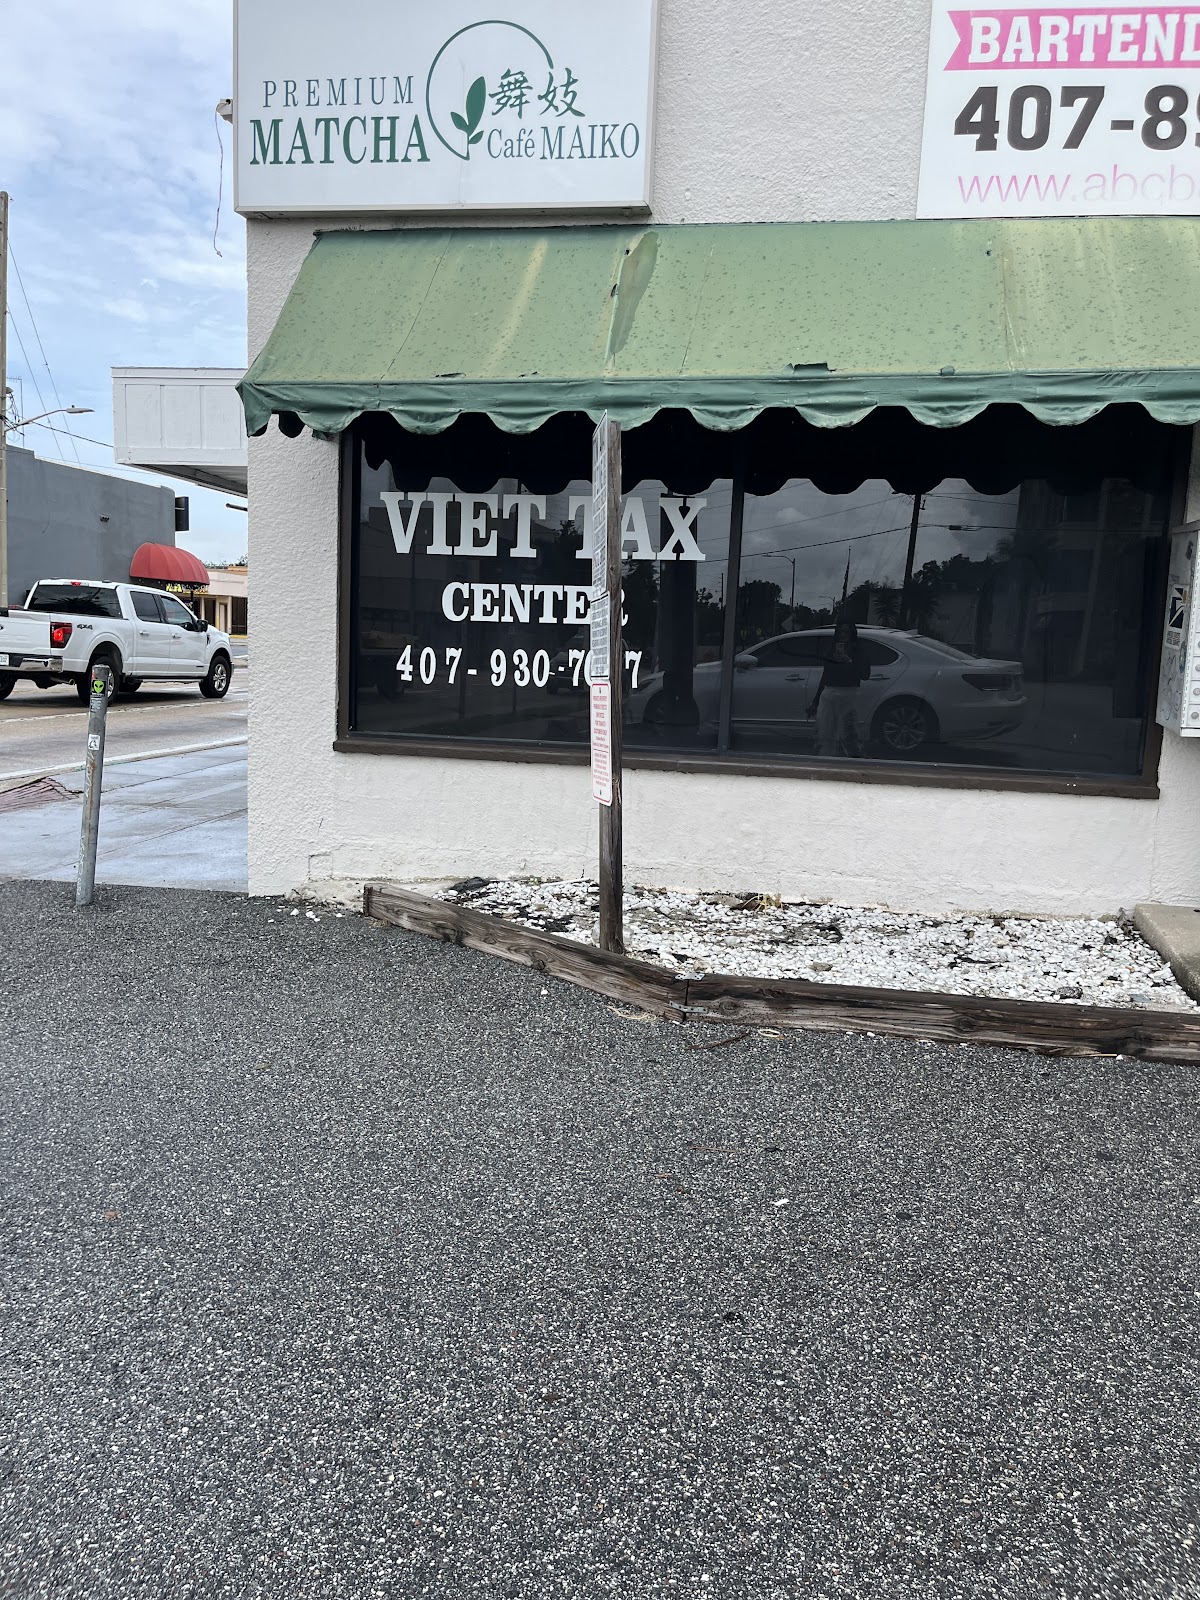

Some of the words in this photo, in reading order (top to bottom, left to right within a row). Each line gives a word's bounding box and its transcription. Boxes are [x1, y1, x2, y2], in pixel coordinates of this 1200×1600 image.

[262, 75, 415, 109] PREMIUM
[488, 67, 586, 120] 舞妓
[249, 113, 431, 166] MATCHA
[486, 127, 536, 160] Café
[539, 122, 641, 161] MAIKO
[953, 84, 1200, 152] 407-8
[957, 163, 1200, 204] www.abcb
[380, 491, 548, 559] VIET
[441, 581, 629, 627] CENTE
